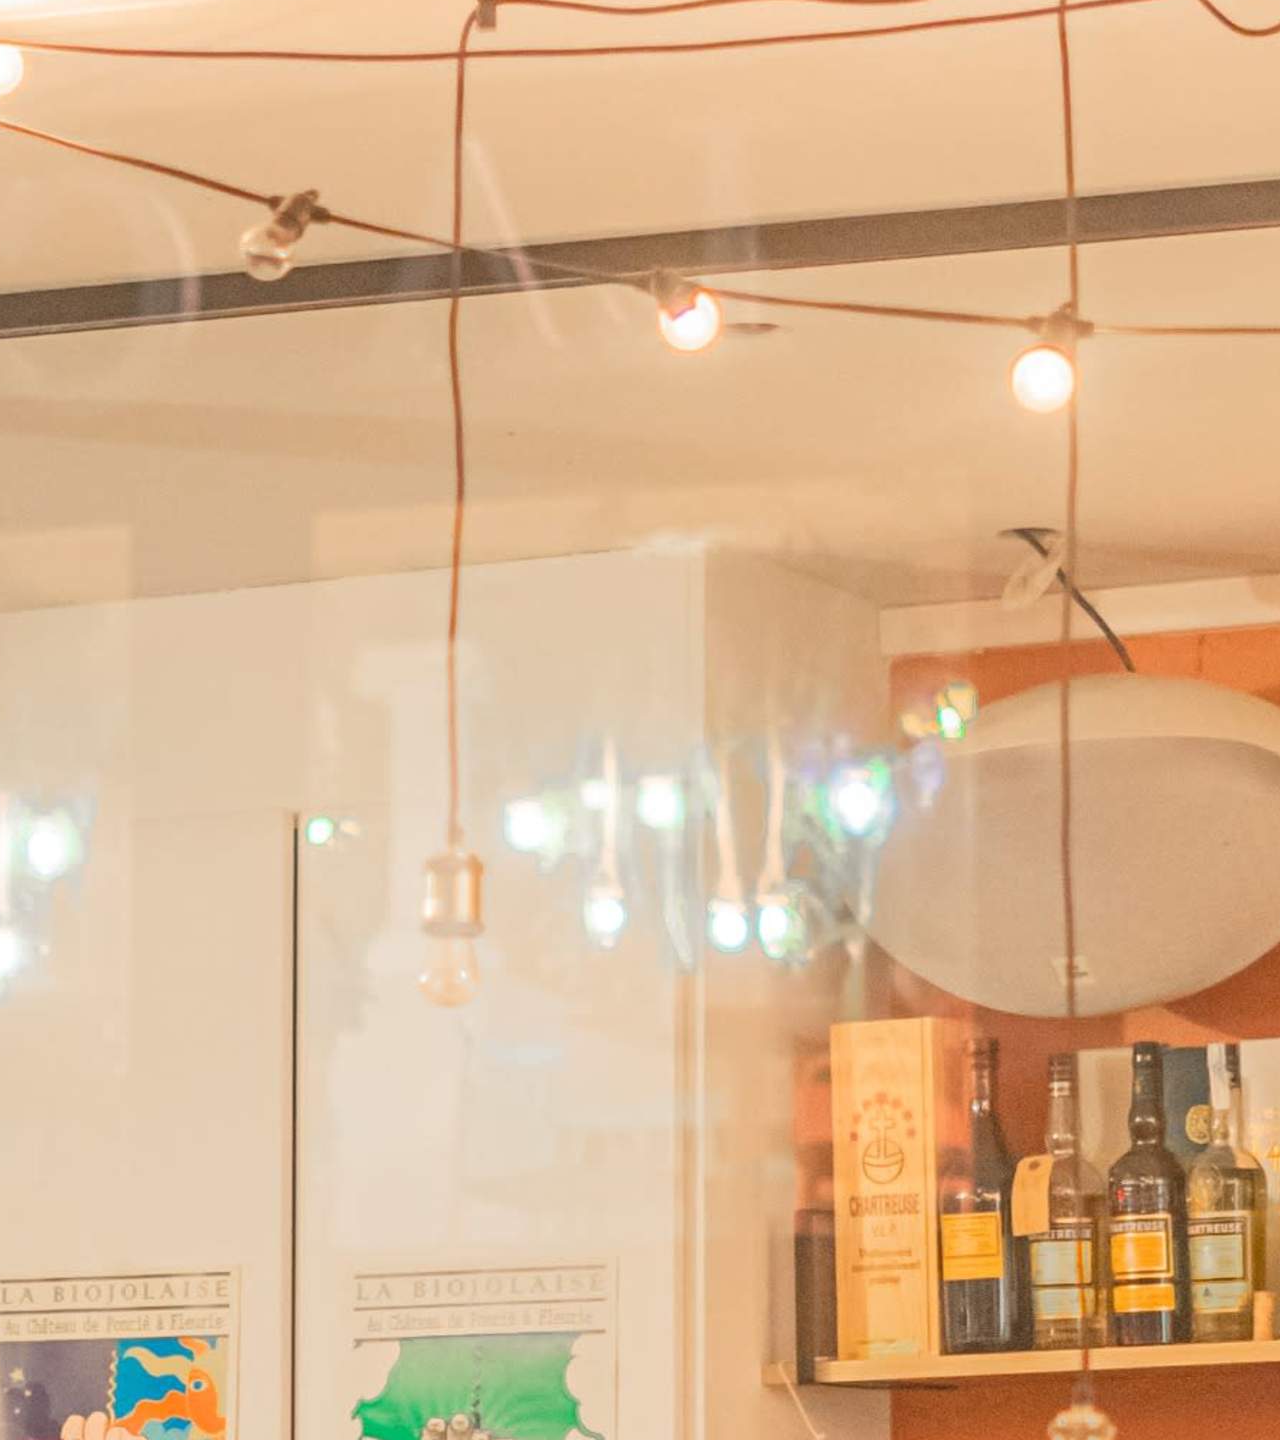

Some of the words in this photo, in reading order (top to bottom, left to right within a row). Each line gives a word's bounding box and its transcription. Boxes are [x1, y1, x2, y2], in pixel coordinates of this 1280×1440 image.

[1, 1286, 35, 1304] LA
[53, 1279, 230, 1303] BIOJOLAISE
[356, 1282, 392, 1301] LA
[413, 1273, 604, 1298] BIOJOLAISE
